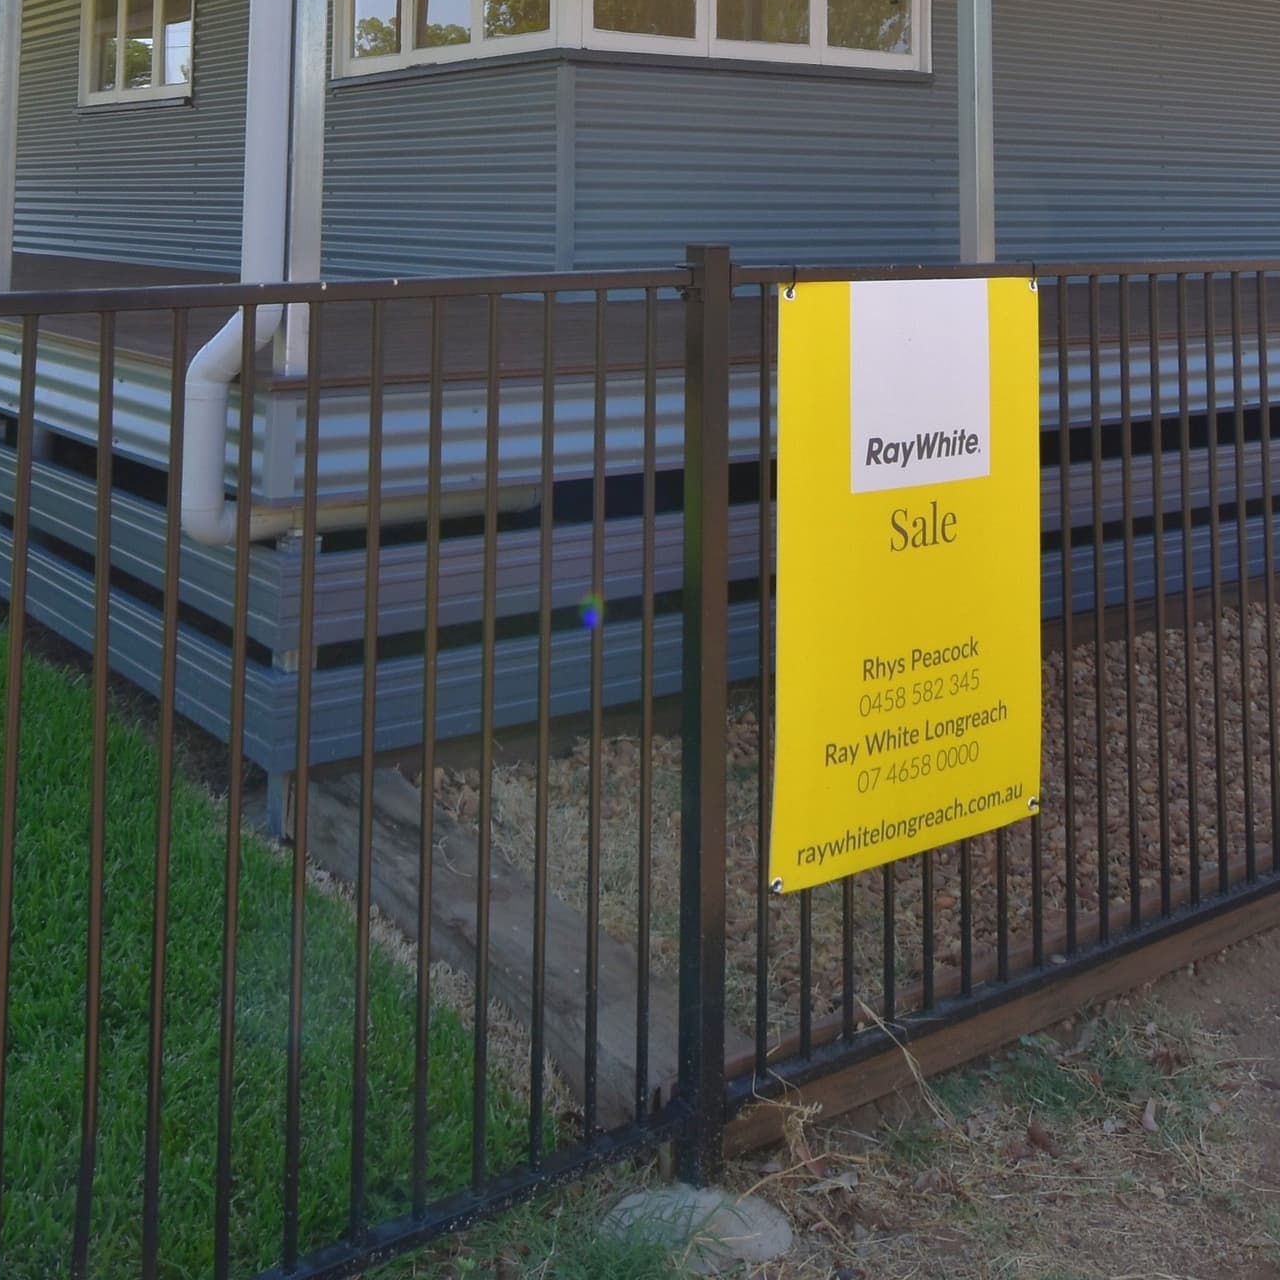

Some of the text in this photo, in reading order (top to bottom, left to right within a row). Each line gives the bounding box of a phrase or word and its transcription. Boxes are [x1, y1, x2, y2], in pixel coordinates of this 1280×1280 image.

[890, 501, 957, 552] Sale
[863, 636, 979, 682] Rhys Peacock
[859, 668, 980, 717] 0458 582 345
[825, 699, 1007, 767] Ray White Longreach
[857, 740, 979, 794] 07 4658 0000
[797, 782, 1023, 866] raywhitelongreach.com.au
